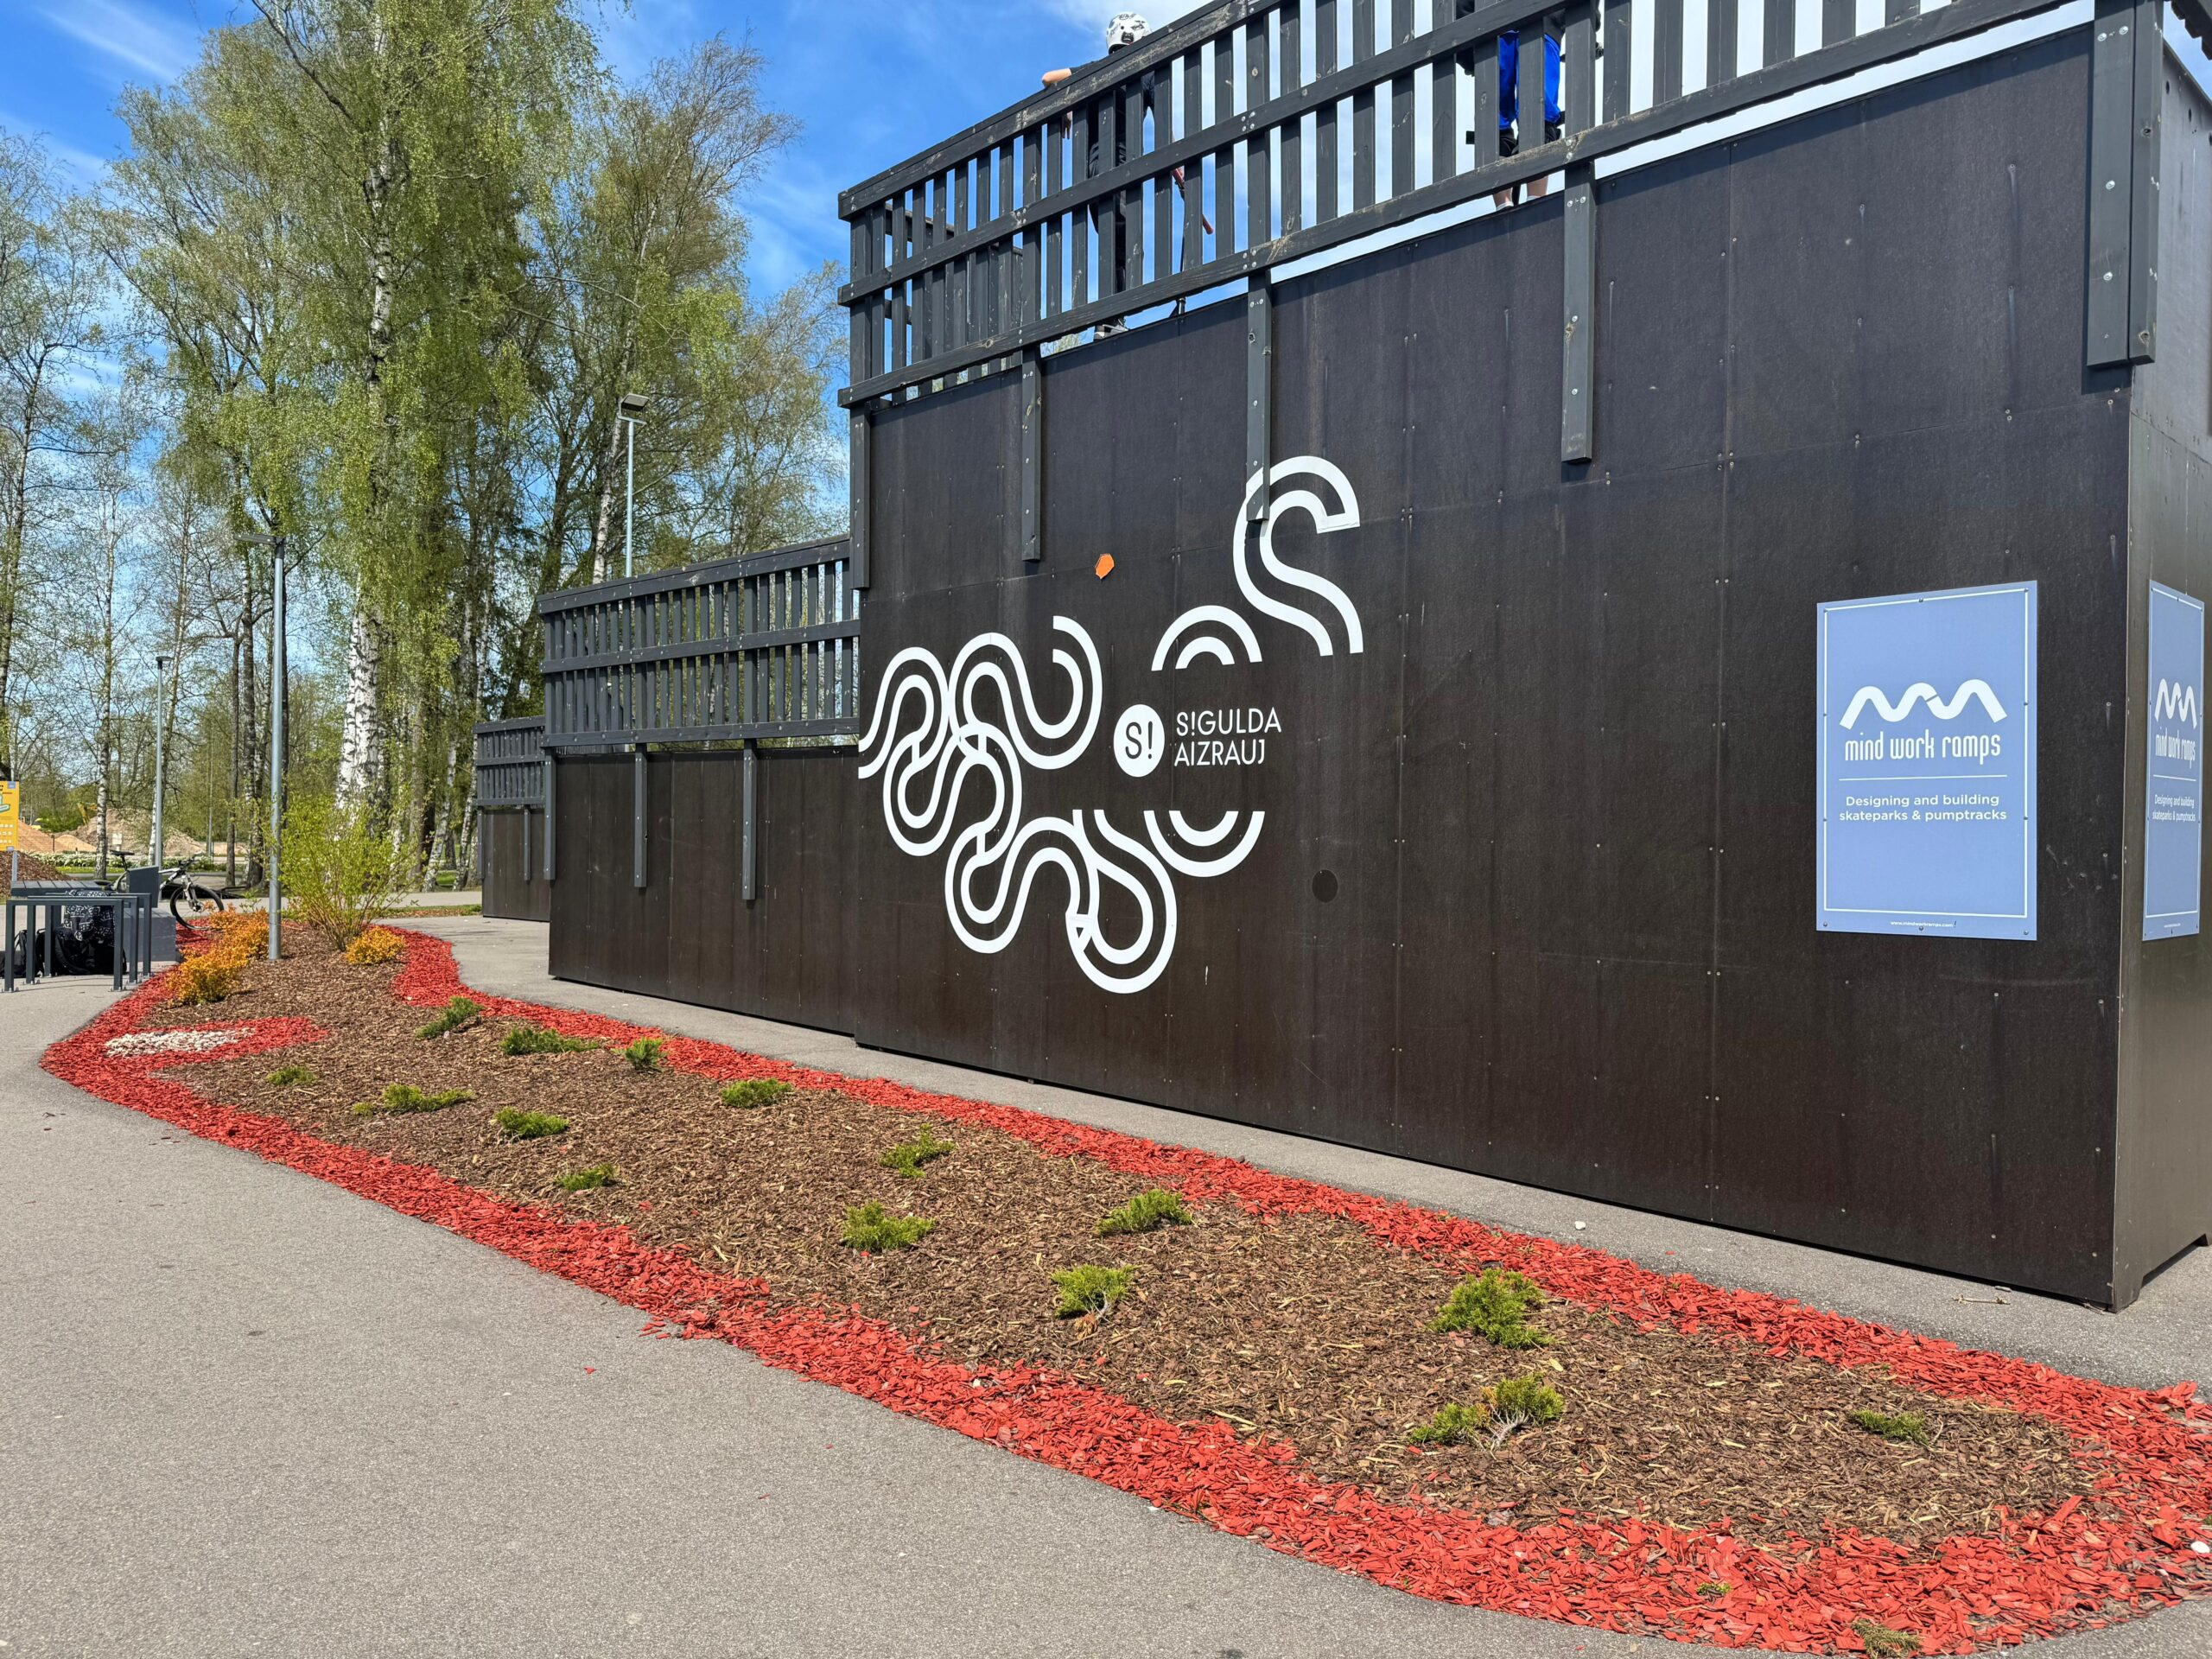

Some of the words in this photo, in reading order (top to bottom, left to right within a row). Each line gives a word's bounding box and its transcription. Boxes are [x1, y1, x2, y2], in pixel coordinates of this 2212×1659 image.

[1125, 721, 1154, 760] S!
[1845, 730, 1884, 761] mind
[1890, 729, 1935, 760] work
[1942, 734, 2001, 766] ramps
[2156, 727, 2167, 757] mind
[2168, 729, 2181, 760] work
[2181, 738, 2196, 769] ramps
[1173, 739, 1265, 767] AIZRAUJ
[1846, 795, 1910, 808] Designing
[1913, 794, 1939, 806] and
[1942, 794, 1999, 807] building
[2154, 794, 2173, 807] Designing
[2181, 797, 2195, 809] building
[1839, 810, 1908, 823] skateparks
[1912, 810, 1922, 821] &
[1924, 809, 2007, 823] pumptracks
[2152, 810, 2172, 822] skateparks
[2176, 812, 2196, 823] pumptracks
